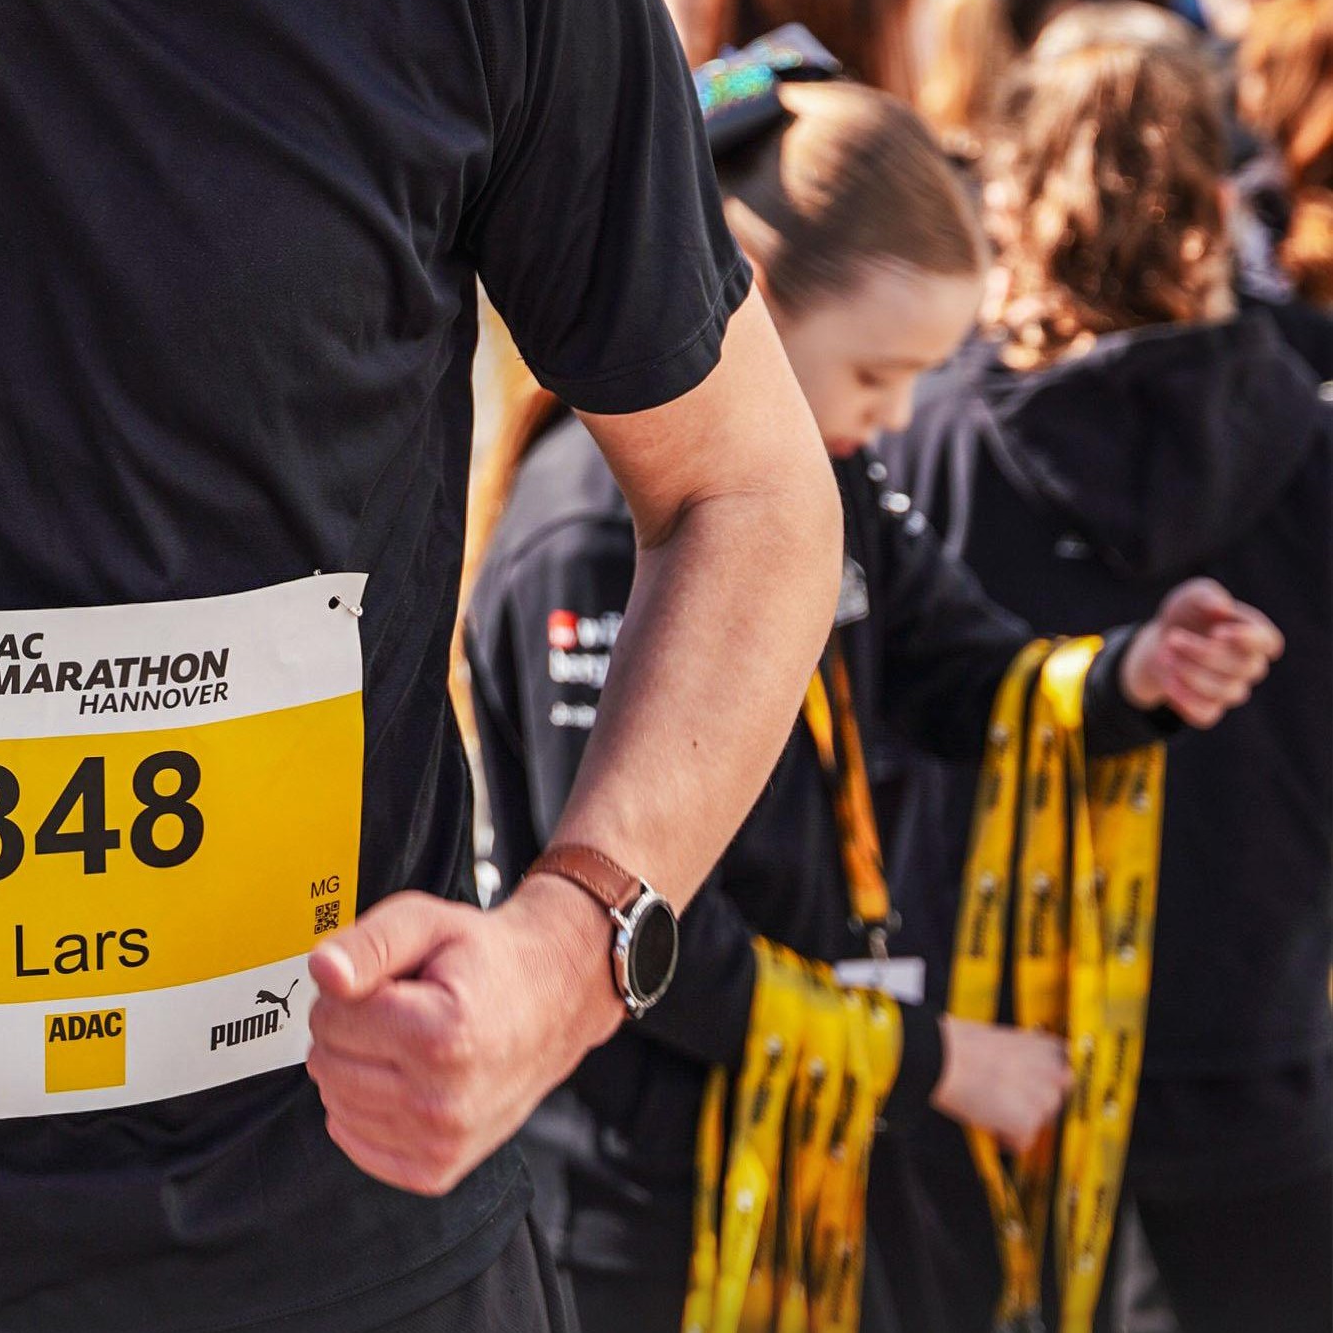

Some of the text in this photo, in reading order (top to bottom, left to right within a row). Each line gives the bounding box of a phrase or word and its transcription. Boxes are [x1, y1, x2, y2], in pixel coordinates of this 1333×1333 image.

[78, 681, 229, 715] HANNOVER
[310, 875, 340, 899] MG
[14, 924, 150, 977] Lars
[48, 1011, 123, 1043] ADAC
[210, 1008, 279, 1052] PUMA
